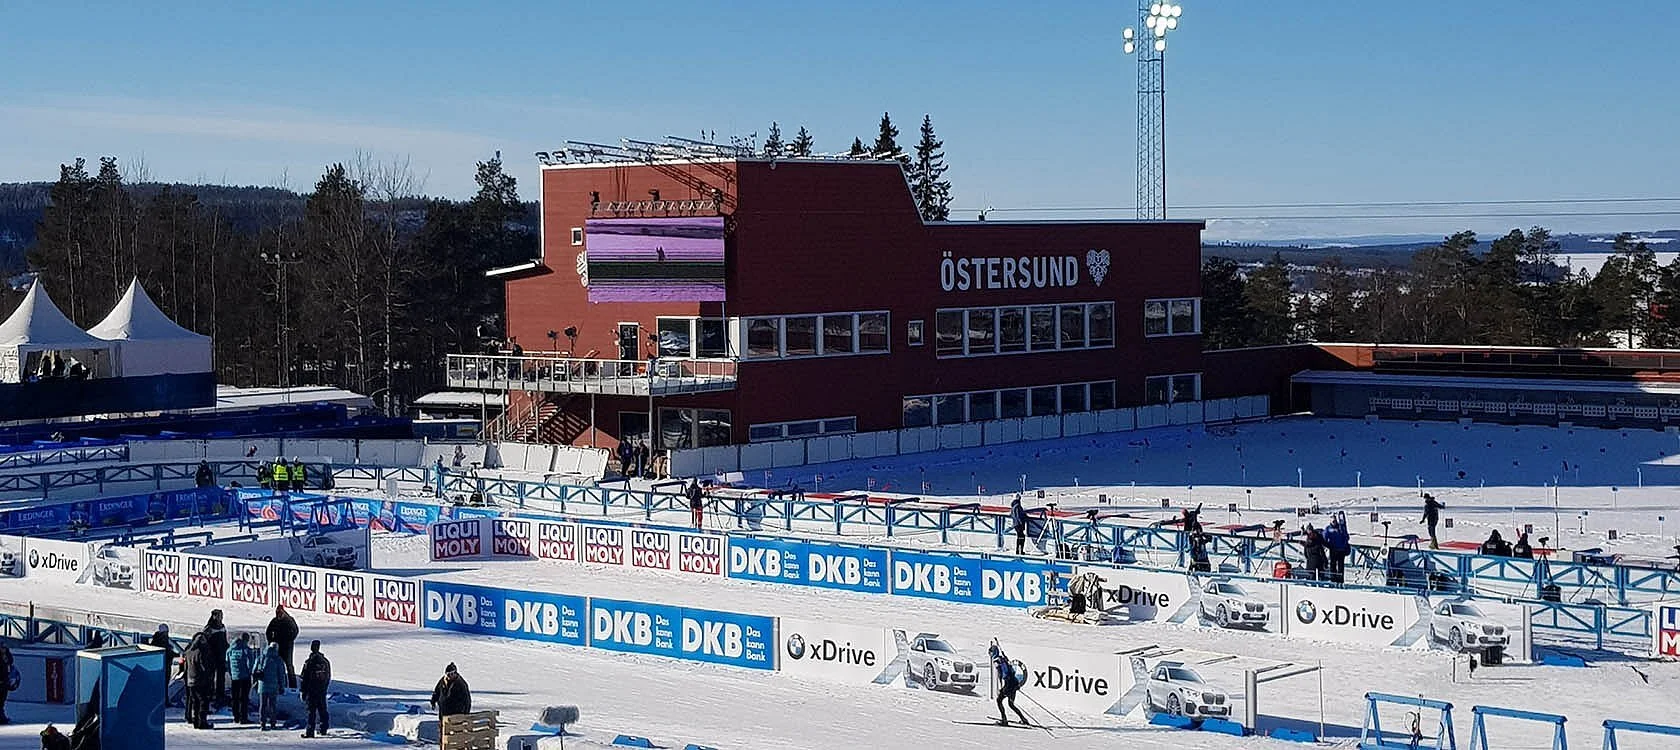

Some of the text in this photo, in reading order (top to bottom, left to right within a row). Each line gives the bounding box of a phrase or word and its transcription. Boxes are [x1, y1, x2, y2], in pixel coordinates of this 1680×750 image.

[940, 251, 1078, 292] ÖSTERSUND
[436, 522, 478, 540] LIQUI
[495, 521, 530, 539] LIQUI
[540, 524, 574, 542] LIQUI
[587, 527, 622, 546] LIQUI
[633, 531, 668, 550] LIQUI
[436, 538, 479, 558] MOLY
[495, 538, 530, 555] MOLY
[540, 541, 574, 560] MOLY
[587, 545, 623, 564] MOLY
[681, 535, 719, 555] LIQUI
[42, 552, 78, 571] xDrive
[147, 554, 178, 574] LIQUI
[189, 558, 222, 578] LIQUI
[633, 549, 669, 569] MOLY
[681, 554, 719, 574] MOLY
[731, 546, 780, 577] DKB
[809, 554, 860, 584] DKB
[147, 572, 179, 592] MOLY
[233, 563, 266, 584] LIQUI
[279, 568, 315, 590] LIQUI
[895, 561, 951, 594] DKB
[189, 577, 223, 597] MOLY
[234, 582, 267, 604] MOLY
[327, 574, 362, 596] LIQUI
[375, 580, 413, 601] LIQUI
[982, 569, 1041, 602] DKB
[280, 587, 316, 610] MOLY
[327, 594, 363, 617] MOLY
[1107, 585, 1170, 607] xDrive
[375, 600, 415, 623] MOLY
[427, 590, 478, 625] DKB
[505, 599, 558, 636] DKB
[1321, 605, 1394, 630] xDrive
[594, 608, 652, 646] DKB
[747, 626, 760, 637] Das
[682, 618, 743, 658] DKB
[746, 650, 766, 661] Bank
[810, 640, 875, 666] xDrive
[1034, 666, 1108, 696] xDrive
